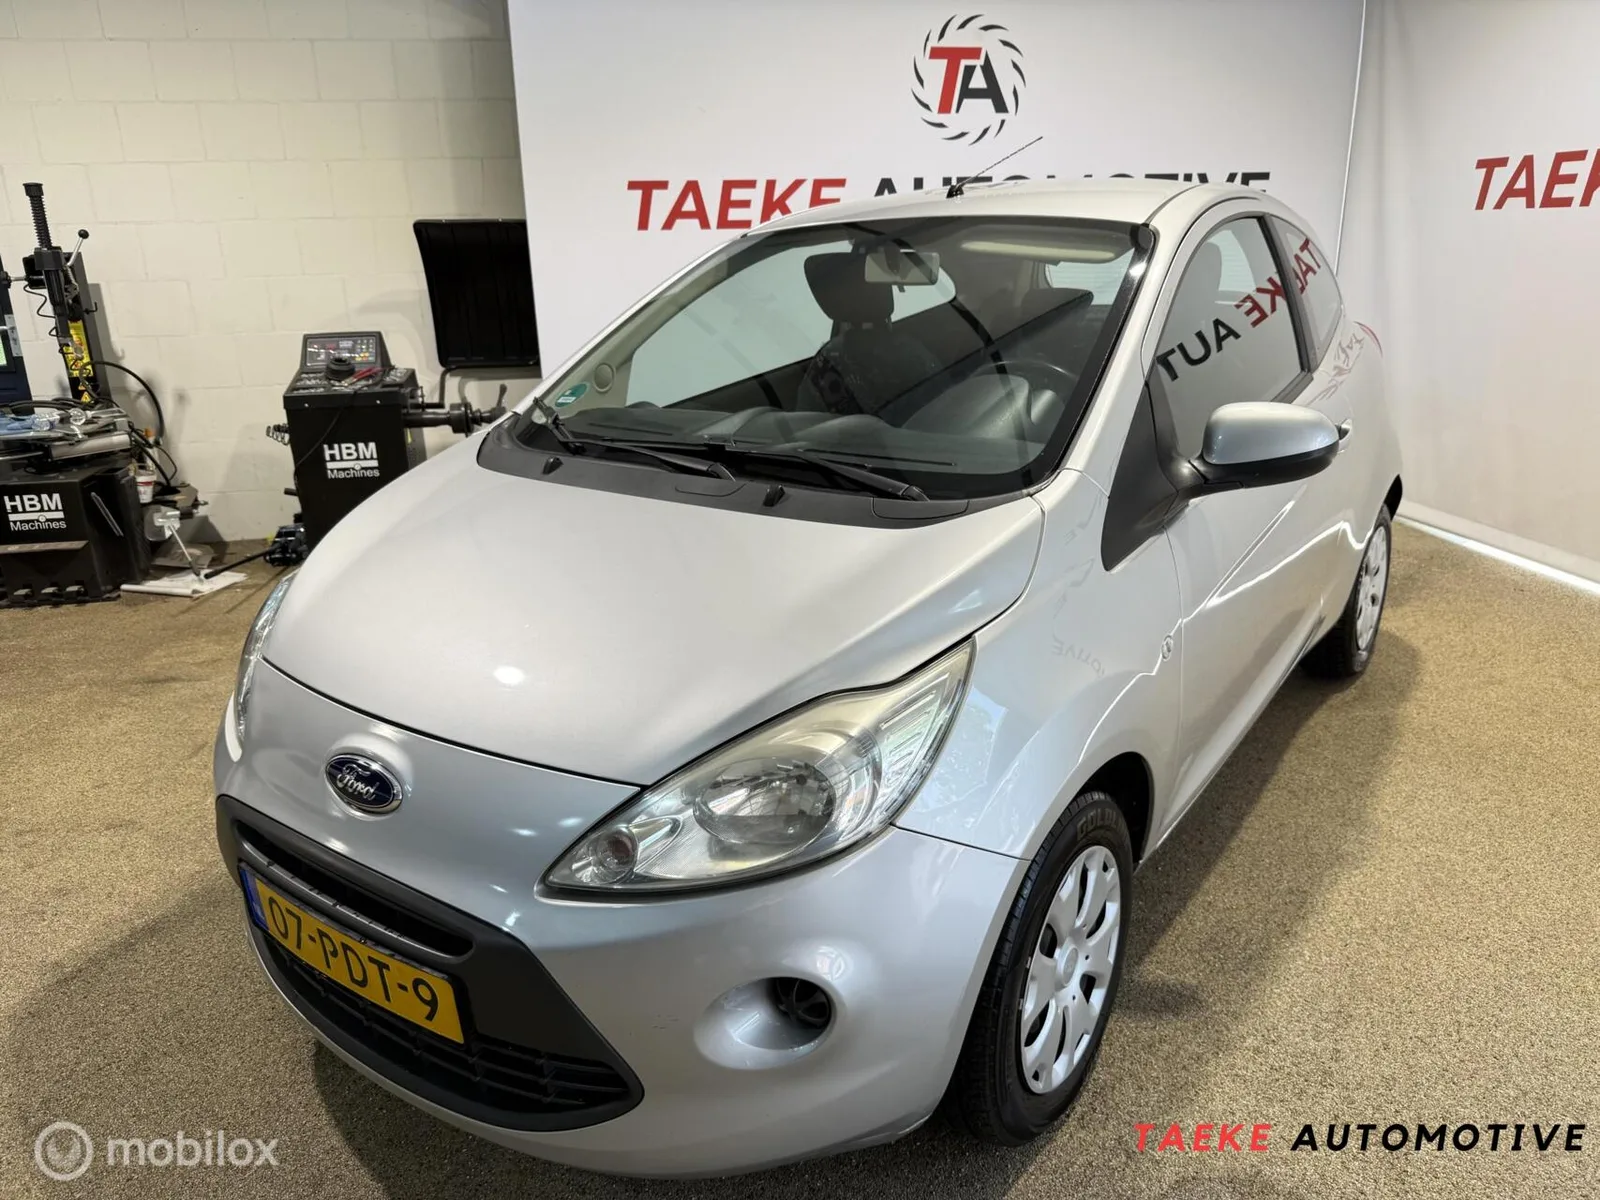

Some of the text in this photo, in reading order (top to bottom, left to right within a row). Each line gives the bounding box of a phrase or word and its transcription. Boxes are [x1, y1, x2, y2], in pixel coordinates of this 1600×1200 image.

[929, 46, 1009, 115] TA
[323, 442, 378, 461] HBM
[327, 469, 380, 479] Machines
[3, 493, 63, 513] HBM
[10, 520, 67, 531] Machines
[336, 763, 380, 800] Ford
[268, 896, 439, 1022] 07-PDT-9
